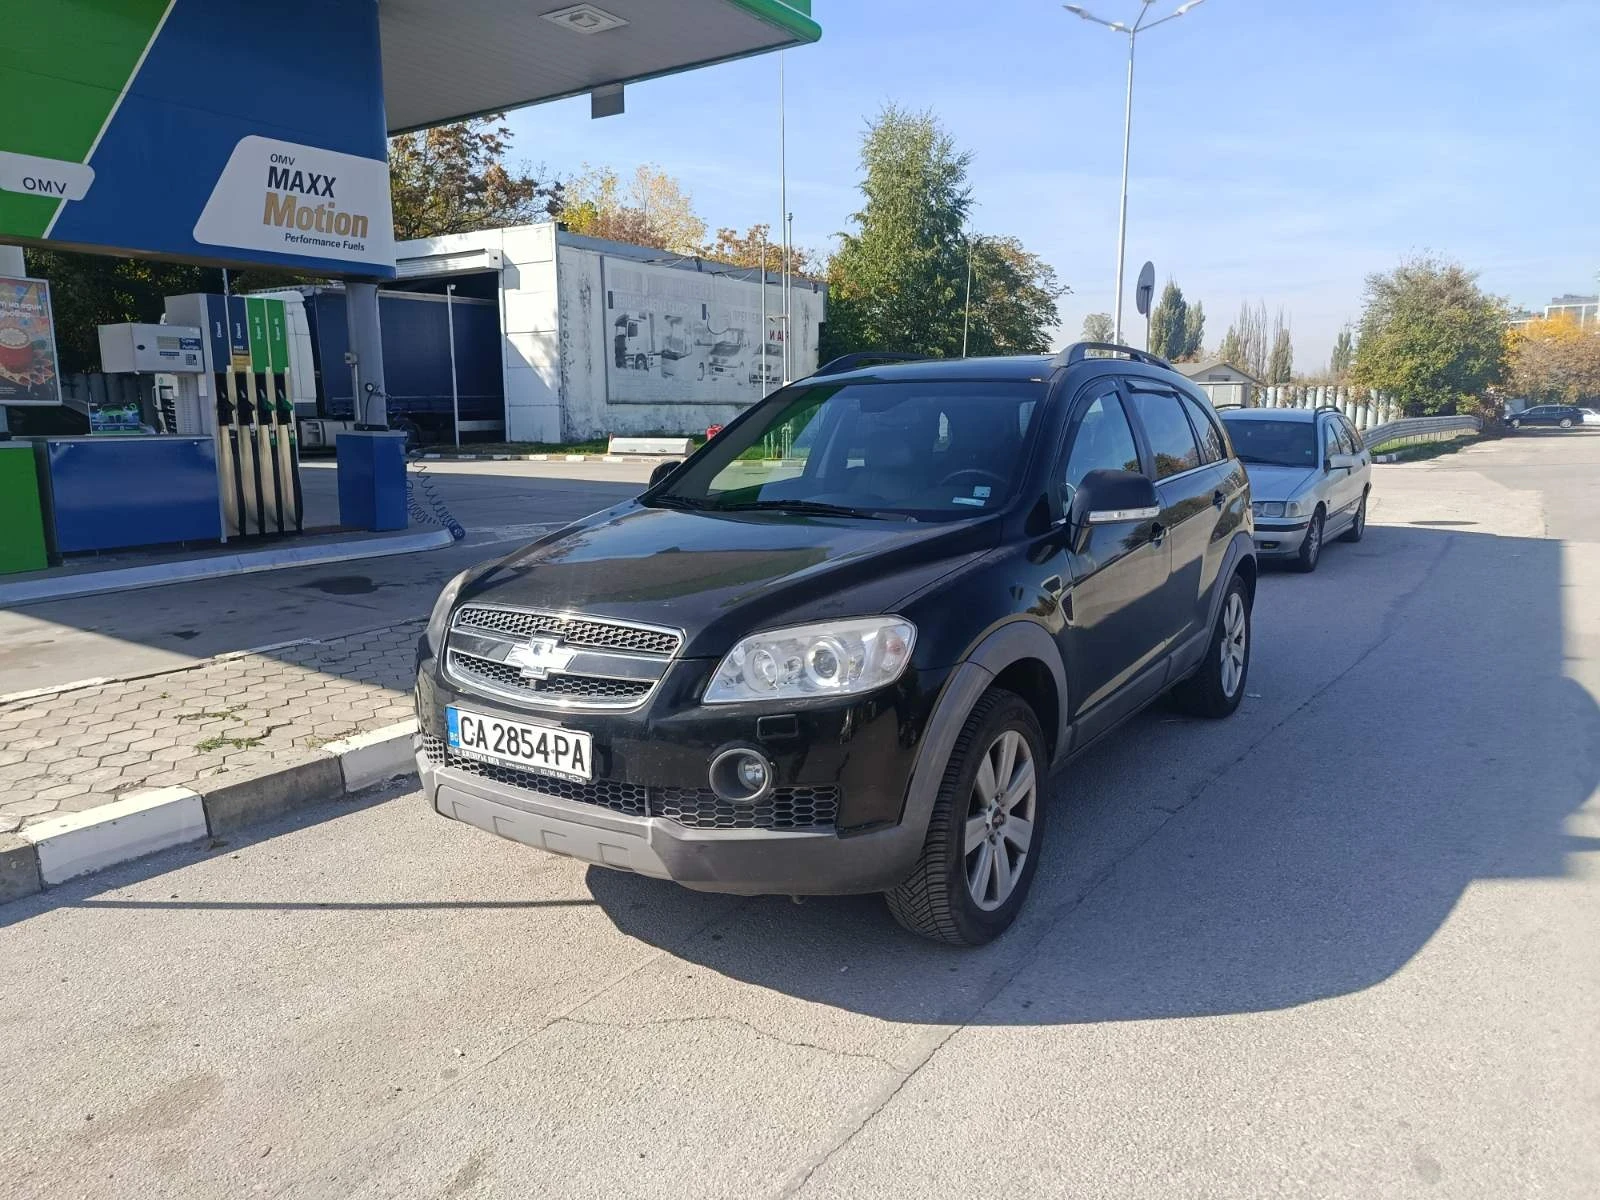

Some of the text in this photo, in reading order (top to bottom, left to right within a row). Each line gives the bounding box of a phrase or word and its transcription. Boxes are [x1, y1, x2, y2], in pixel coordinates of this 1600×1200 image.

[270, 153, 296, 166] OMV
[22, 177, 67, 195] OMV
[267, 165, 337, 198] MAXX
[262, 191, 369, 239] Motion
[284, 233, 365, 251] Performance Fuels
